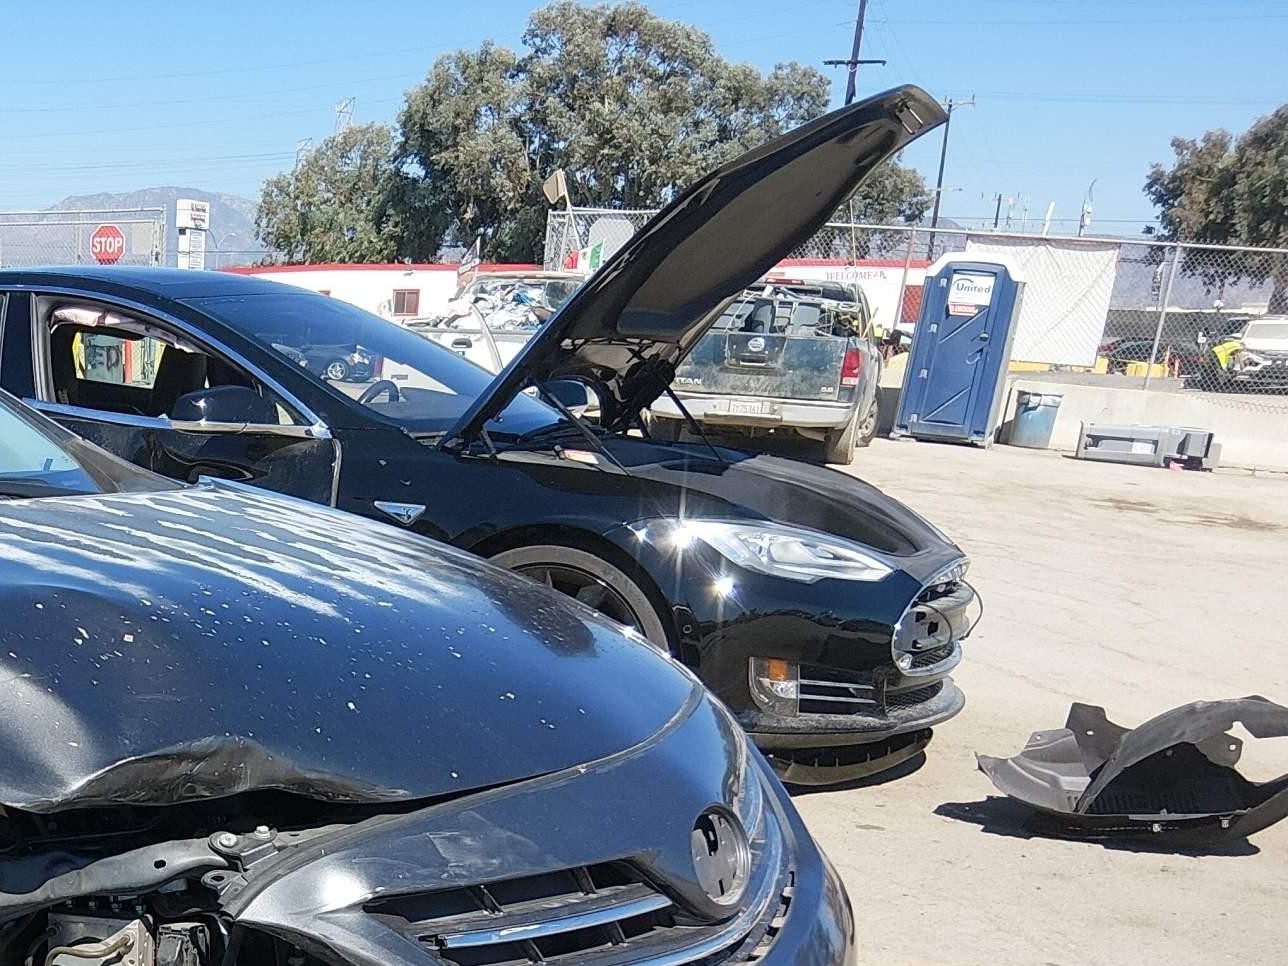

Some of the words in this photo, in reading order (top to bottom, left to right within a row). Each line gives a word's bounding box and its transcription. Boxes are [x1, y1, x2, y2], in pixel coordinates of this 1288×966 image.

[93, 237, 122, 253] STOP
[826, 271, 873, 281] WELCOME
[956, 282, 991, 293] United
